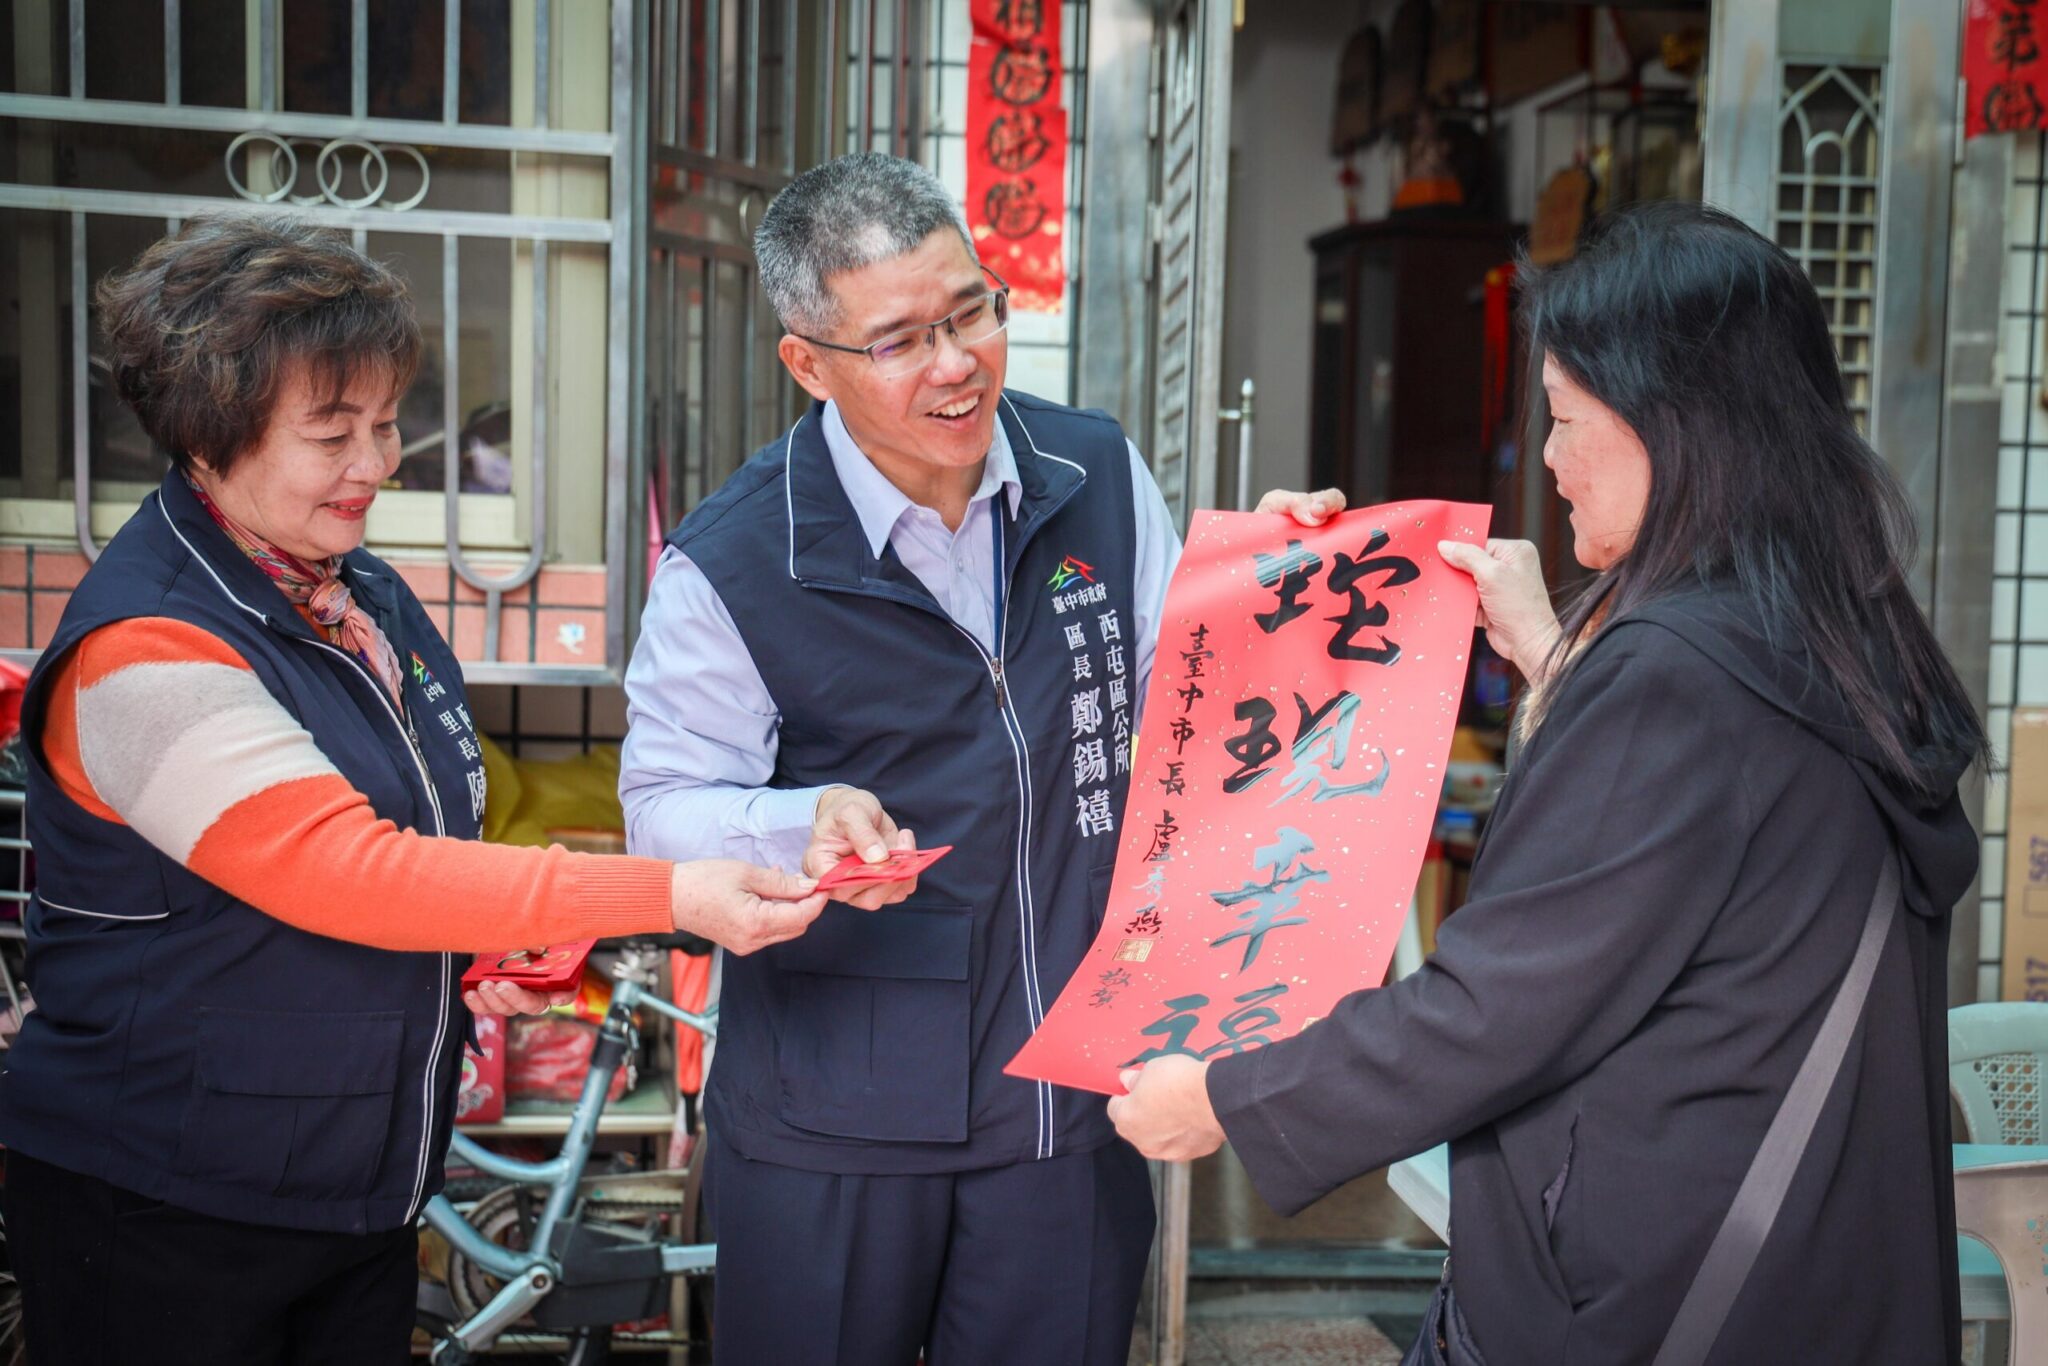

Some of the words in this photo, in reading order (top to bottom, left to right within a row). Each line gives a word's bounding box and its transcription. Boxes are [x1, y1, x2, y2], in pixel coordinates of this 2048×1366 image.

[1052, 582, 1107, 614] 臺中市政府
[1098, 609, 1130, 776] 西屯區公所
